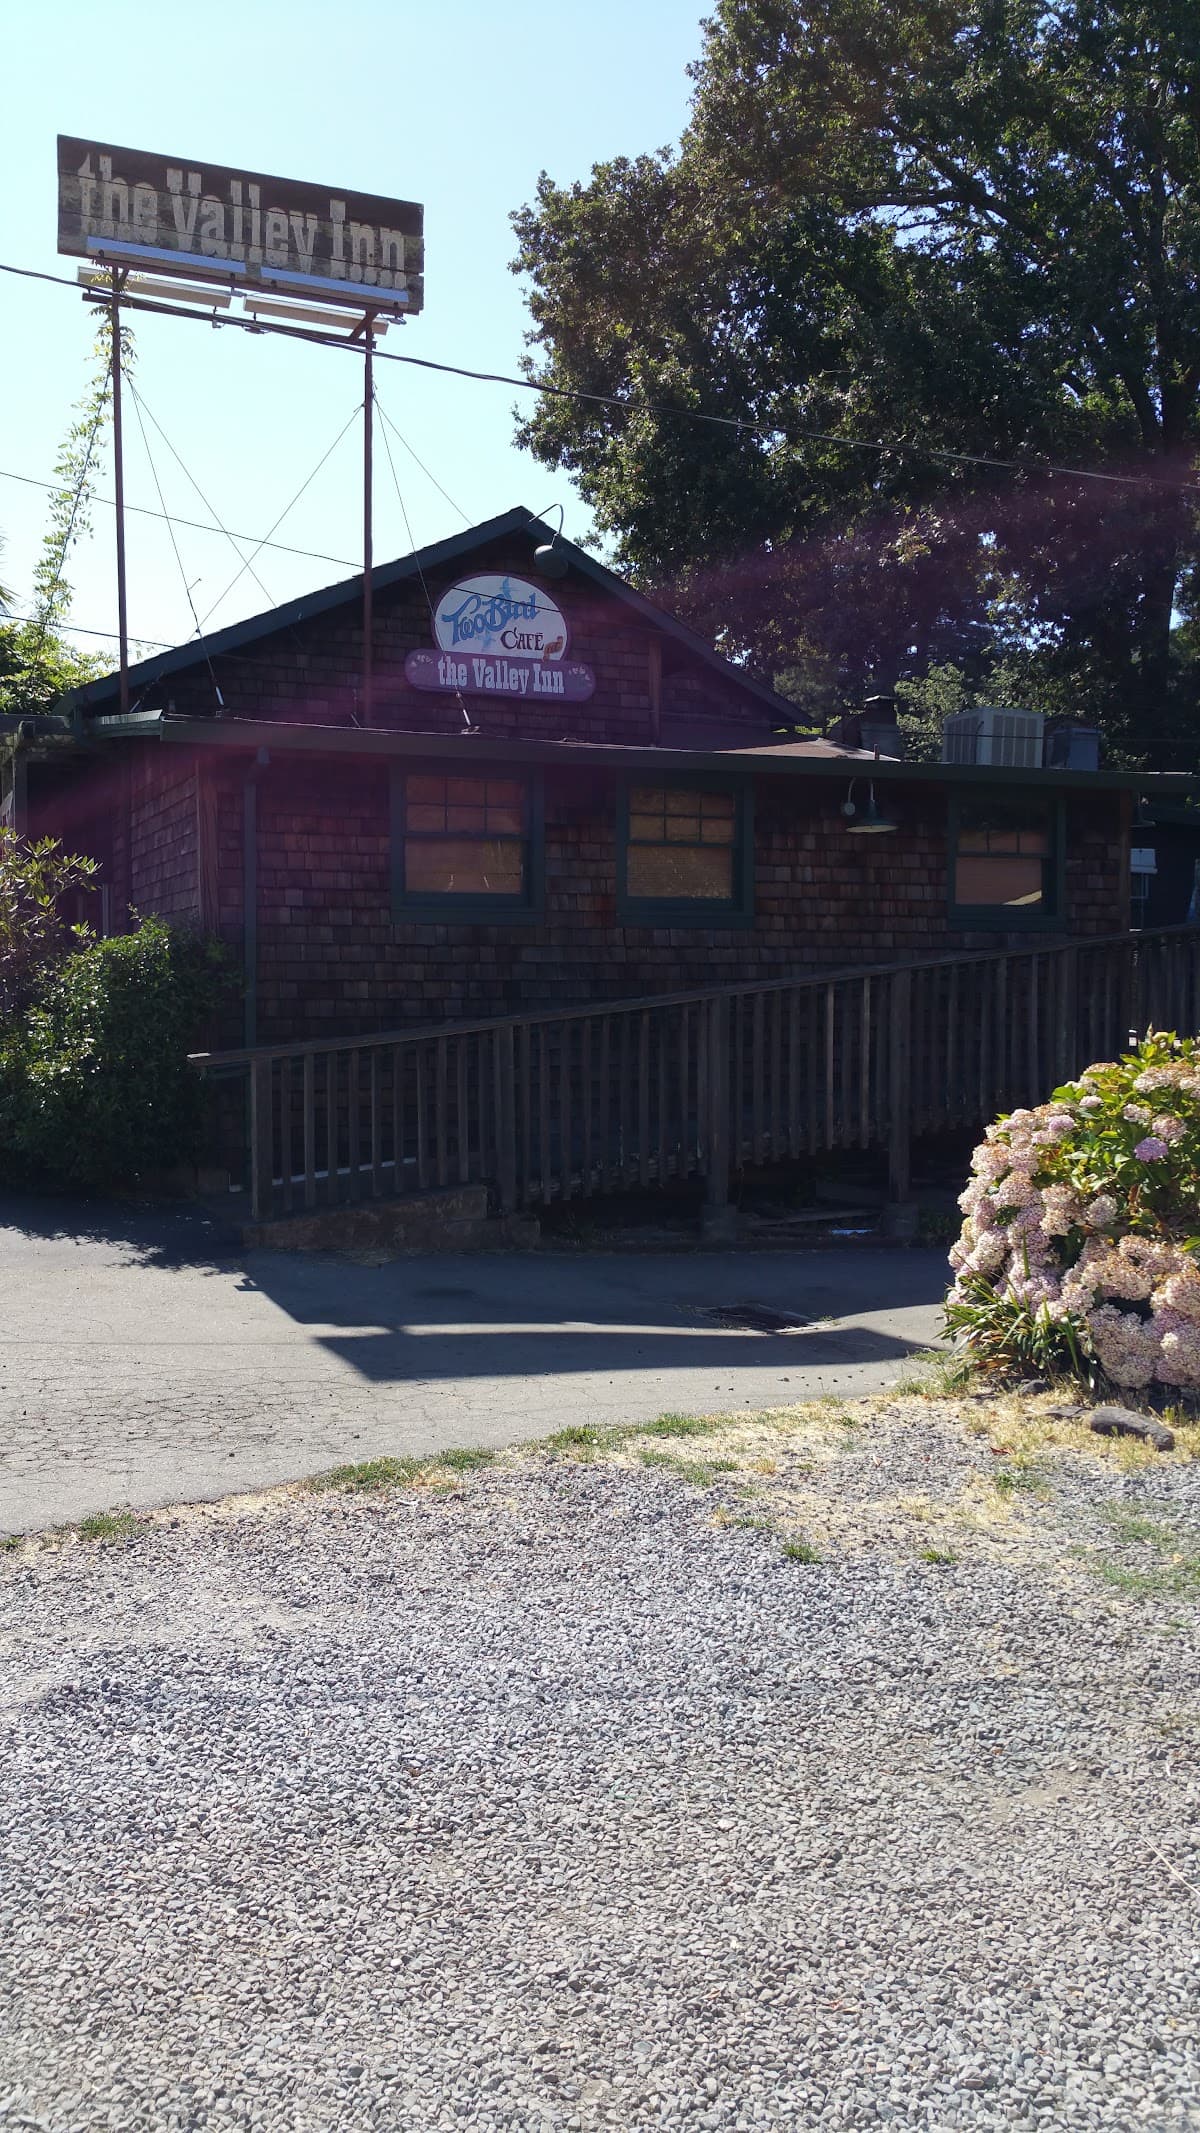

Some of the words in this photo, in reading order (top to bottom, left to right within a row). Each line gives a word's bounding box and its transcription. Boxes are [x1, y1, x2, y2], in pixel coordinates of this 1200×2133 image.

[78, 152, 160, 243] the
[165, 167, 318, 275] Valley
[328, 199, 408, 290] Inn
[438, 656, 468, 687] the
[472, 658, 530, 695] Valley
[533, 663, 565, 694] Inn
